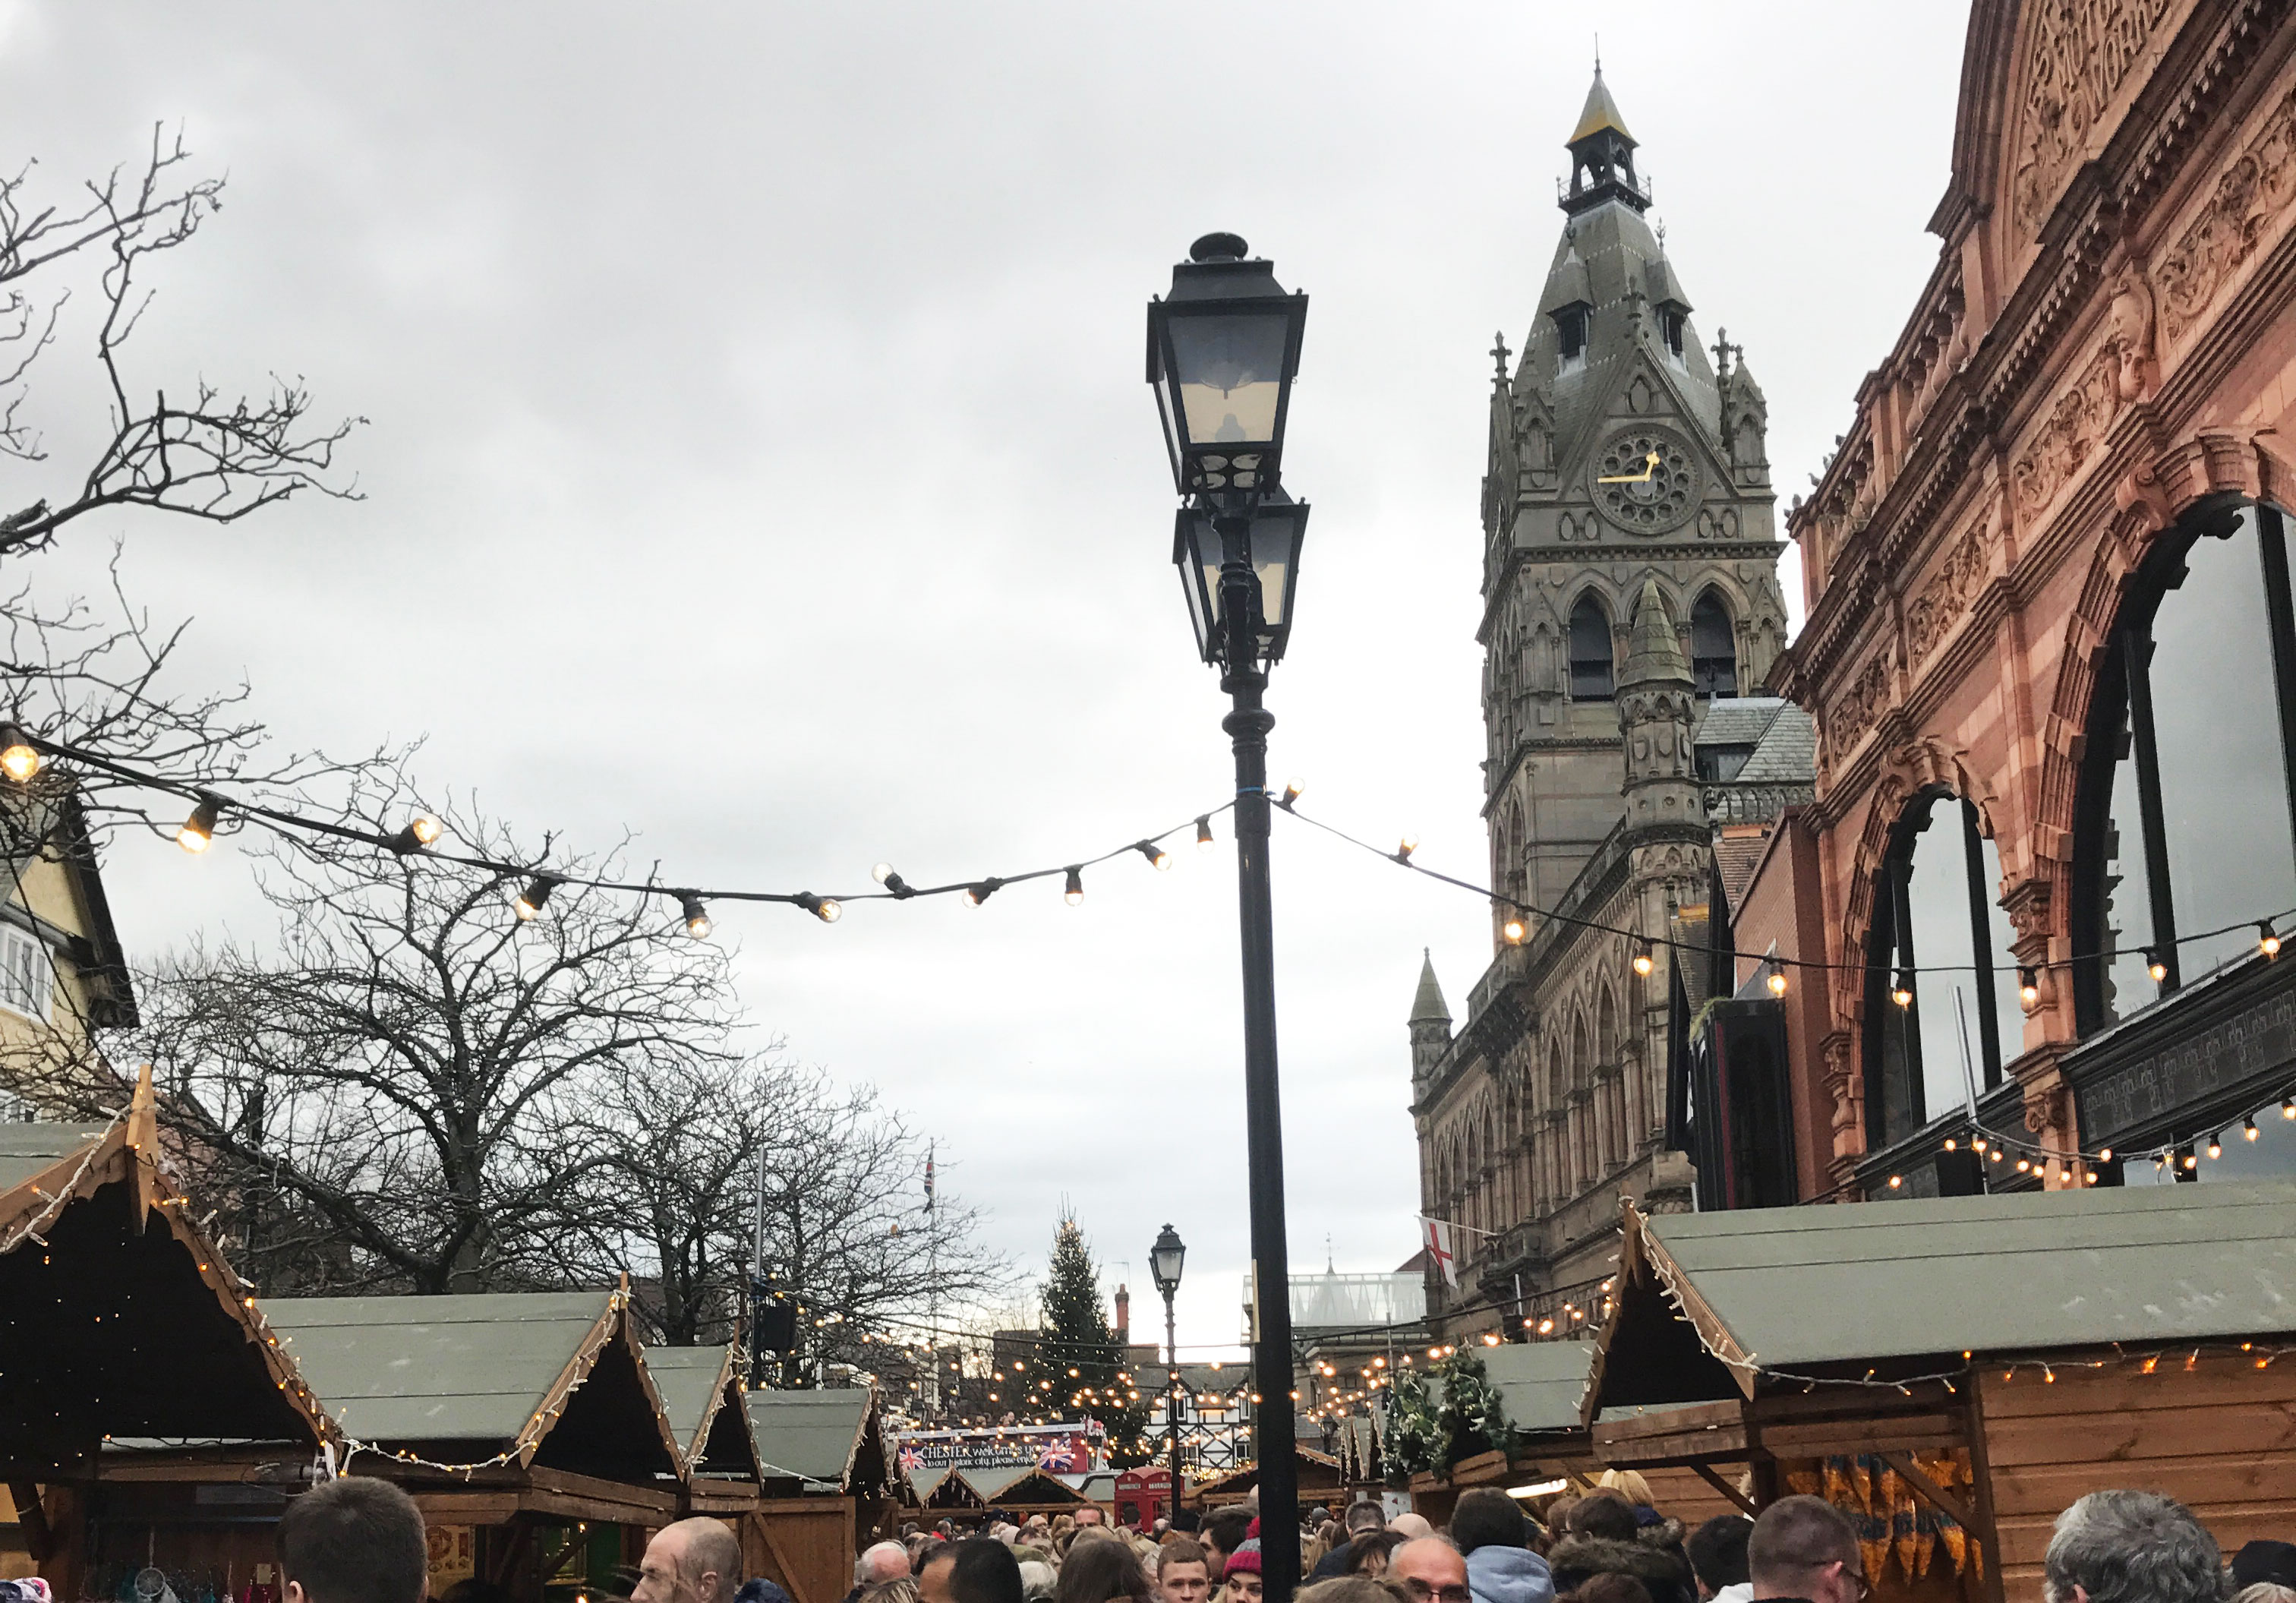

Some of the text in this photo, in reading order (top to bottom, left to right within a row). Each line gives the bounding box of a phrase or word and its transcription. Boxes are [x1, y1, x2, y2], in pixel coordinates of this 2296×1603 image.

[921, 1445, 973, 1459] CHESTER
[1024, 1444, 1041, 1457] yo
[927, 1459, 934, 1468] to
[992, 1456, 1015, 1466] please
